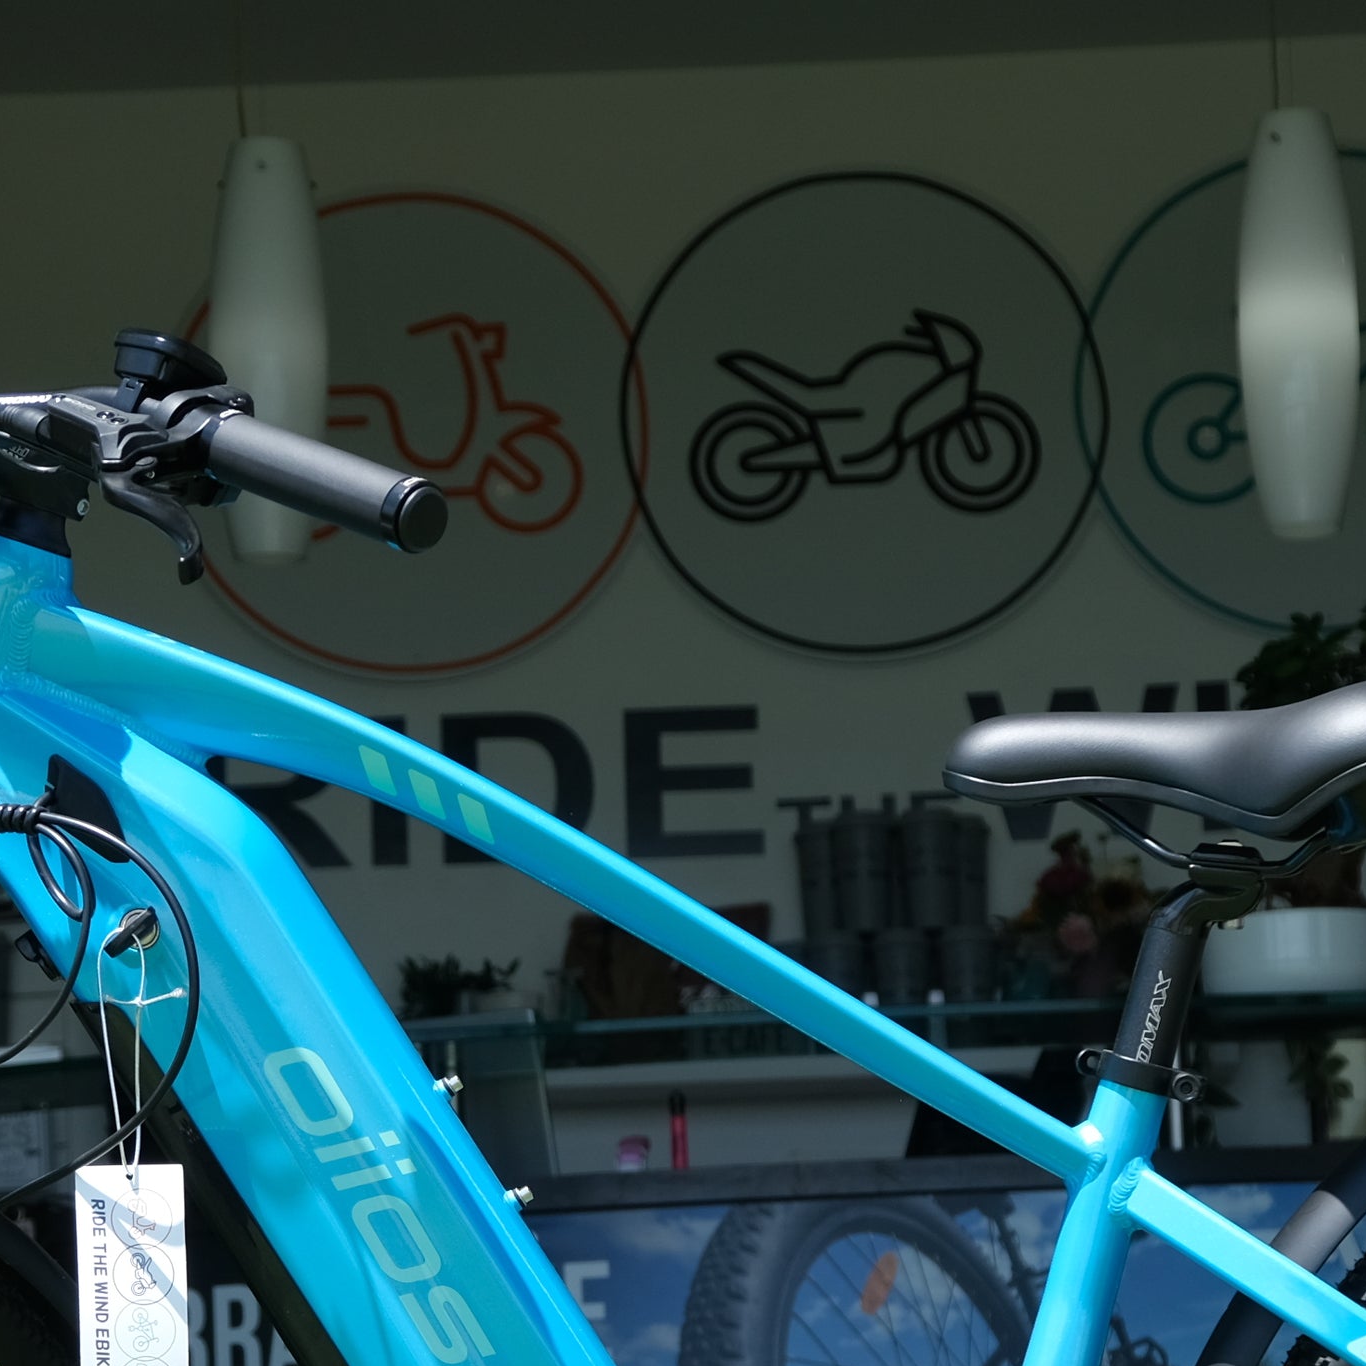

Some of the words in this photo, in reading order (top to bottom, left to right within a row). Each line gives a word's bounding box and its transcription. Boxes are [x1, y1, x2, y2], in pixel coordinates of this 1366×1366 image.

[91, 1198, 106, 1237] RIDE
[263, 1046, 497, 1364] oiios
[93, 1243, 108, 1276] THE
[94, 1281, 109, 1323] WIND
